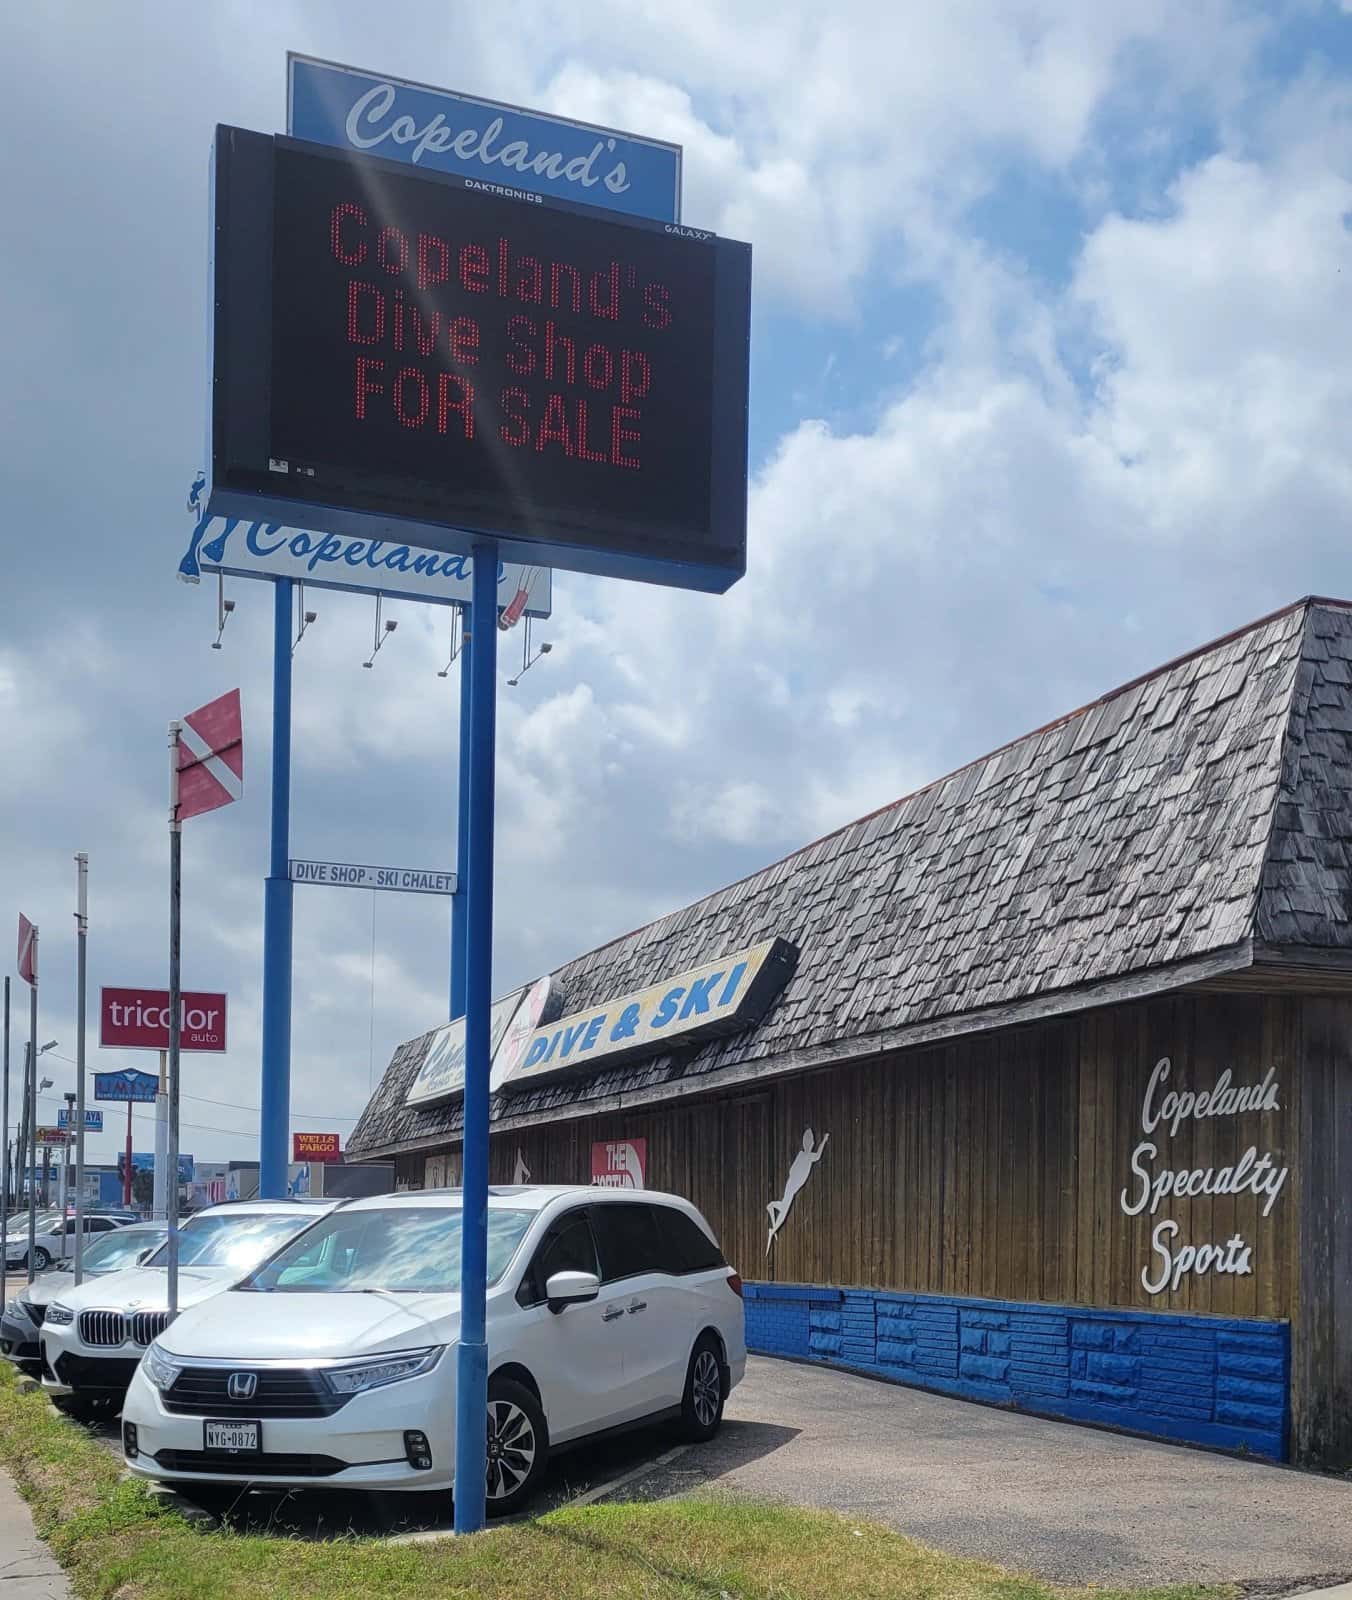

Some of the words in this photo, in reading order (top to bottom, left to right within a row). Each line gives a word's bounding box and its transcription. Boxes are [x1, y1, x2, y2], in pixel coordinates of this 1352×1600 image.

[345, 84, 631, 193] Copeland's
[464, 179, 543, 204] DAKTRONICS
[330, 203, 673, 329] Copeland's
[664, 224, 711, 241] GALAXY
[346, 279, 481, 365] Dive
[506, 314, 652, 405] Shop
[353, 357, 476, 439] FOR
[500, 386, 642, 469] SALE
[296, 863, 327, 880] DIVE
[330, 866, 366, 884] SHOP
[376, 870, 399, 886] SKI
[402, 873, 453, 890] CHALET
[190, 1031, 218, 1043] auto
[522, 1018, 606, 1070] DIVE
[609, 1002, 640, 1042] &
[650, 961, 749, 1029] SKI
[1142, 1056, 1280, 1137] Copelands
[299, 1135, 335, 1144] WELLS
[299, 1143, 335, 1152] FARGO
[606, 1143, 626, 1171] THE
[1121, 1142, 1289, 1217] Specialty
[1141, 1219, 1252, 1295] Sports
